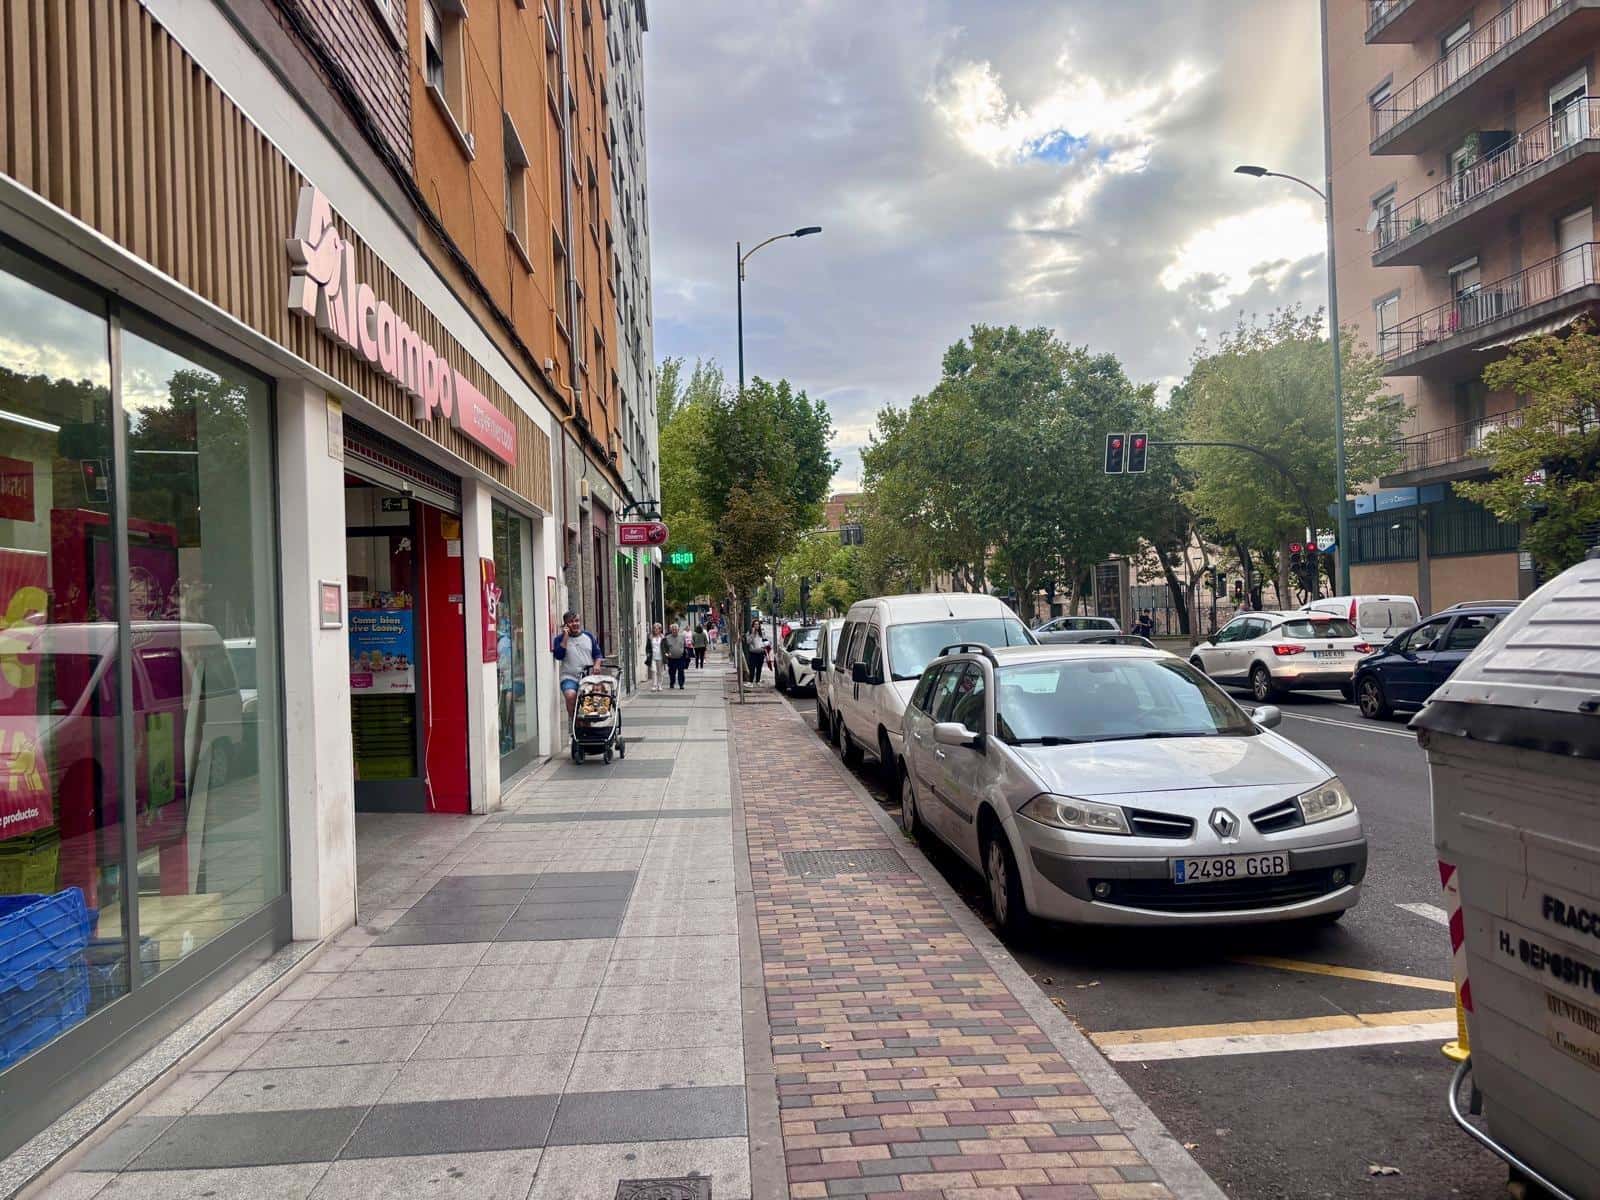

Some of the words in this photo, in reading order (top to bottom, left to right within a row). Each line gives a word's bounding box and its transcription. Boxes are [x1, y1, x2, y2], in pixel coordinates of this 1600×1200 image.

[288, 185, 453, 422] Alcampo
[380, 615, 401, 624] bien
[3, 808, 40, 828] productos
[1188, 859, 1236, 880] 2498
[1246, 856, 1284, 876] GGB
